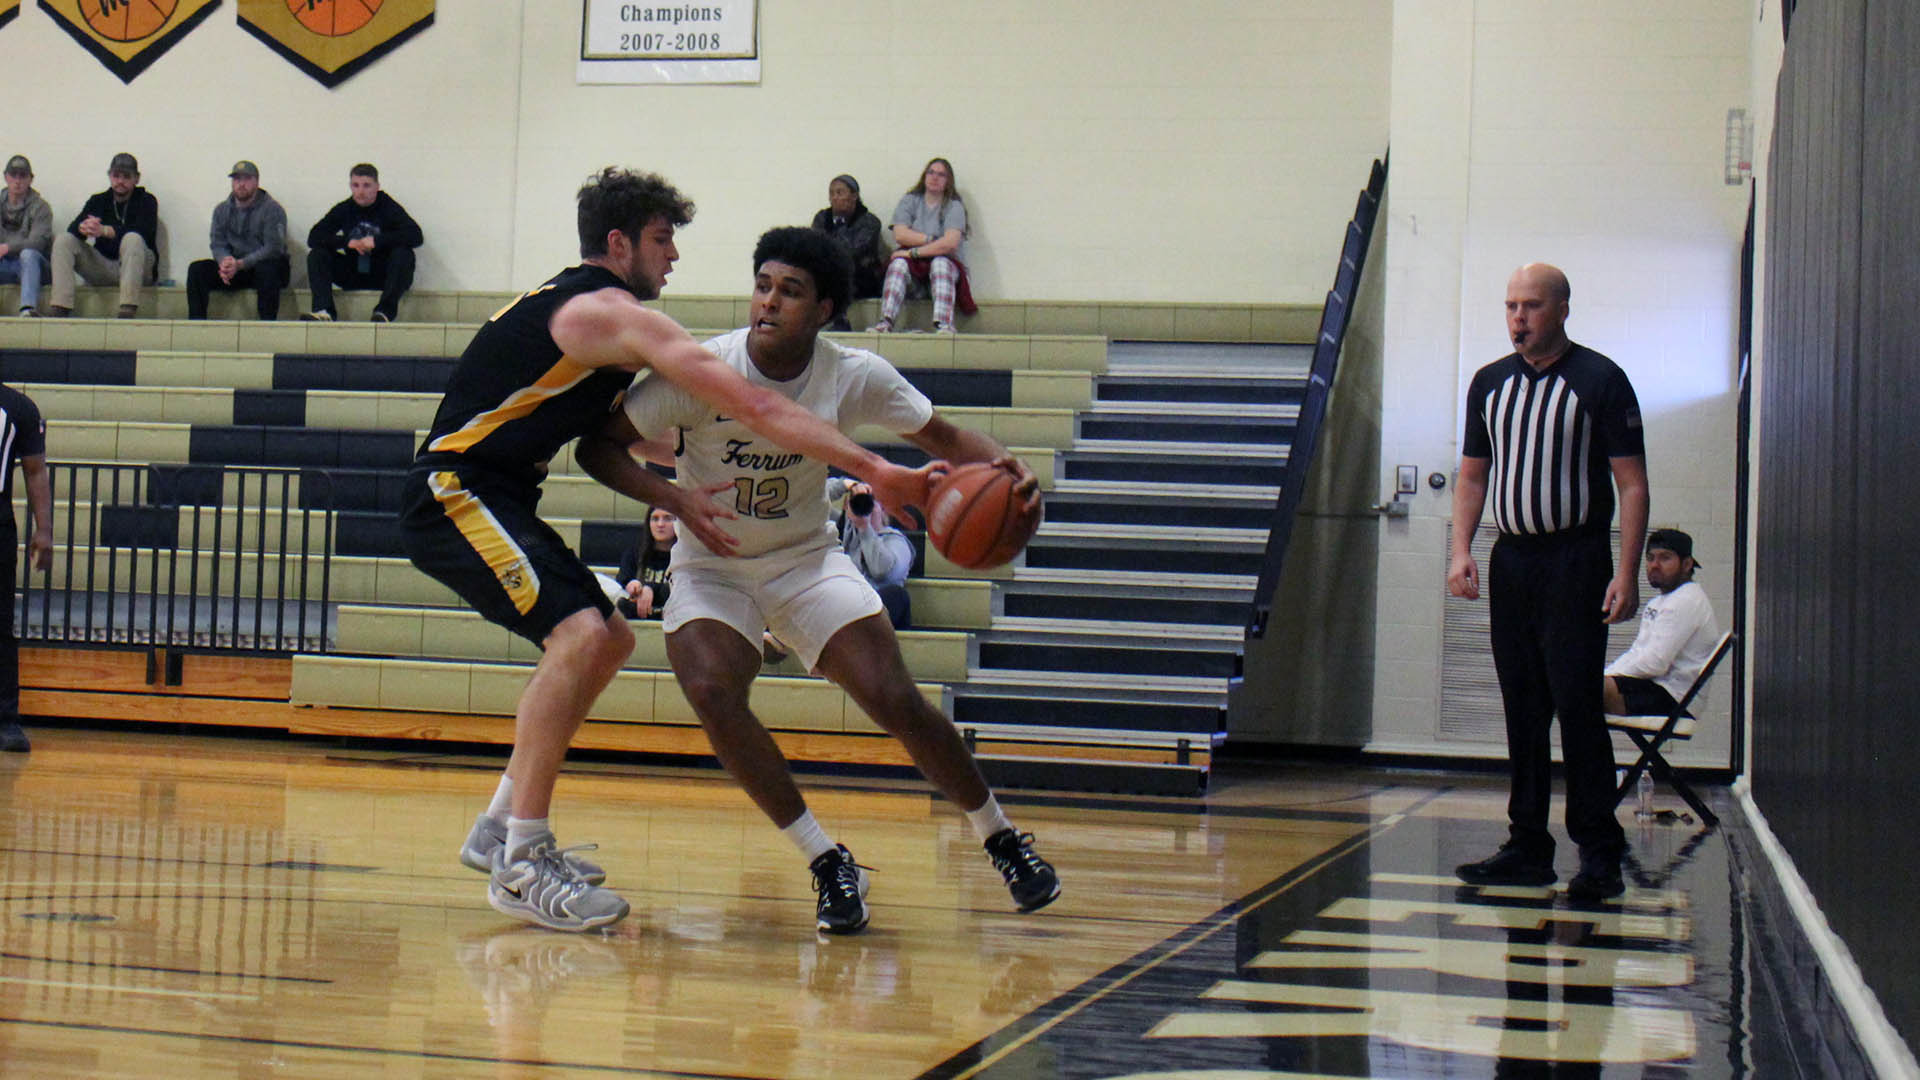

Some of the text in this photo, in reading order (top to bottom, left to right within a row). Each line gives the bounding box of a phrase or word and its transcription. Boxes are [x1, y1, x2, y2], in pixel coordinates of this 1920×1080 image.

[620, 4, 723, 25] Champions
[619, 33, 721, 51] 2007-2008
[720, 438, 805, 472] Ferrum
[734, 476, 790, 520] 12
